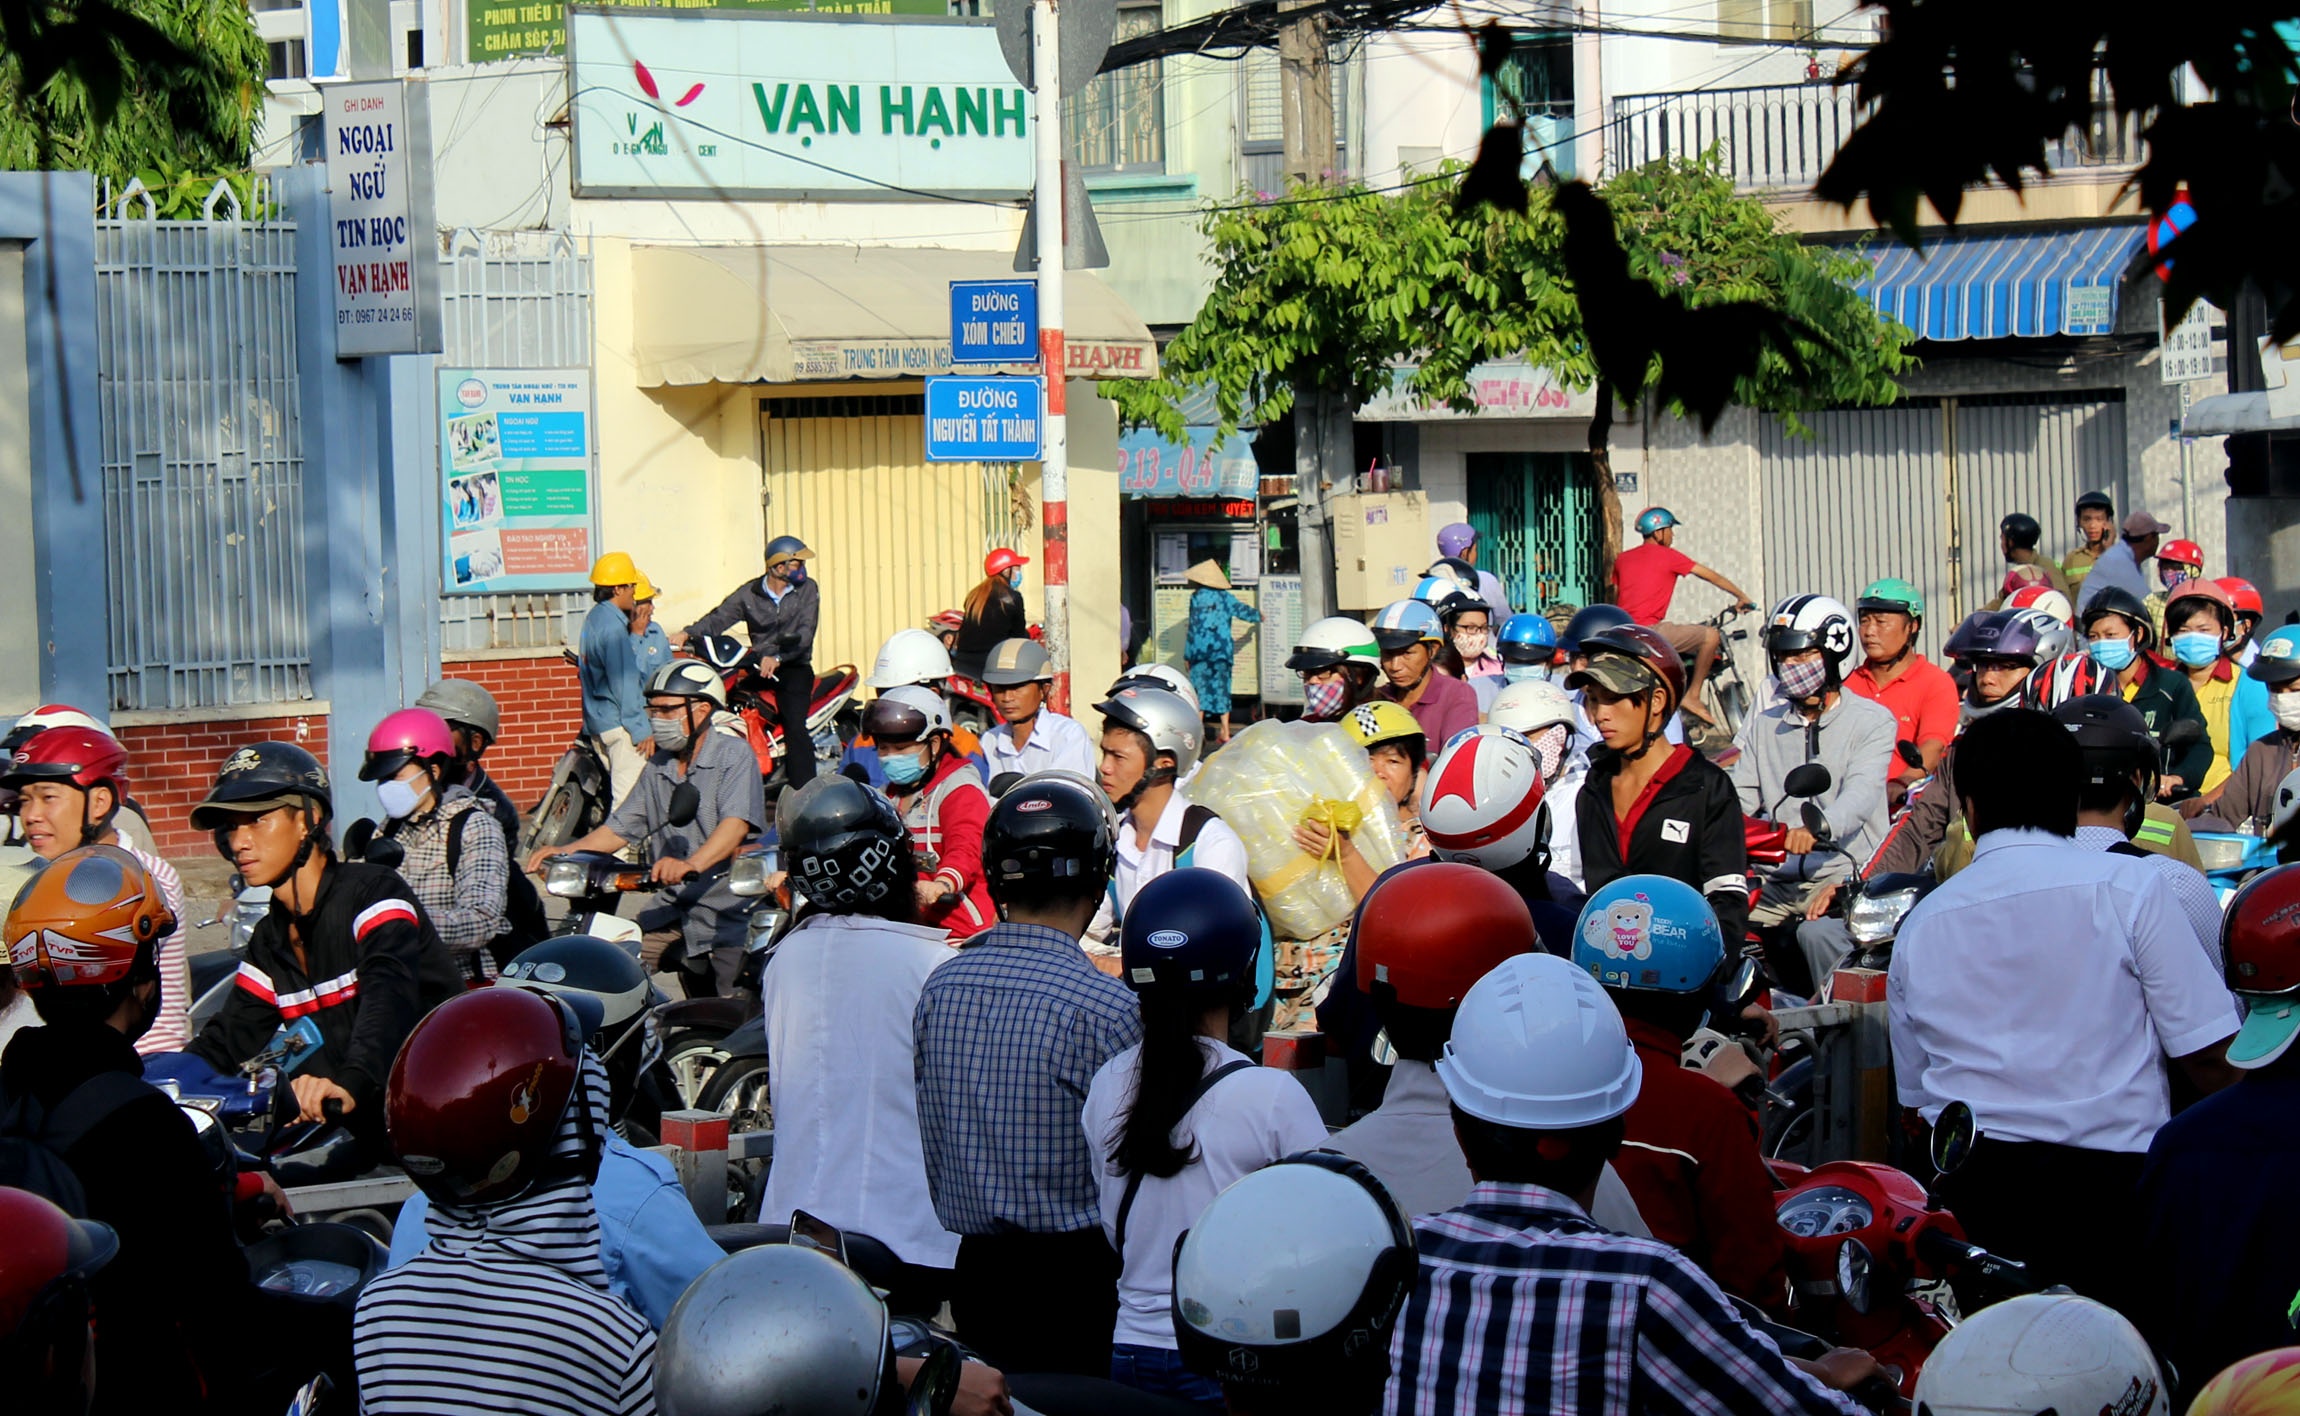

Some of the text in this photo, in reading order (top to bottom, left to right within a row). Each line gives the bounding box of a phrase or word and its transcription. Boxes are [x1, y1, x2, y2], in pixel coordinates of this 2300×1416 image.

[519, 2, 552, 23] THÊU
[856, 0, 892, 15] THÂN
[485, 29, 521, 51] CHĂM
[344, 96, 385, 112] GHI DANH
[752, 83, 1026, 150] VẠN HẠNH
[338, 123, 394, 159] NGOẠI
[349, 161, 386, 201] NGỮ
[337, 216, 406, 252] TIN HỌC
[338, 261, 409, 301] VẠN HẠNH
[971, 289, 1019, 312] ĐƯỜNG
[355, 308, 376, 324] 0967
[378, 307, 389, 323] 24
[390, 307, 401, 322] 24
[402, 306, 413, 322] 66
[962, 315, 1025, 346] XÓM CHIẾU
[843, 348, 876, 370] TRUNG
[879, 342, 900, 369] TÂM
[902, 347, 932, 372] NGOẠI
[958, 386, 1018, 409] ĐƯỜNG
[933, 411, 1036, 443] NGUYỄN TẤT THÀNH
[1652, 922, 1687, 940] BEAR
[18, 945, 35, 959] TVP
[47, 942, 75, 955] TVP
